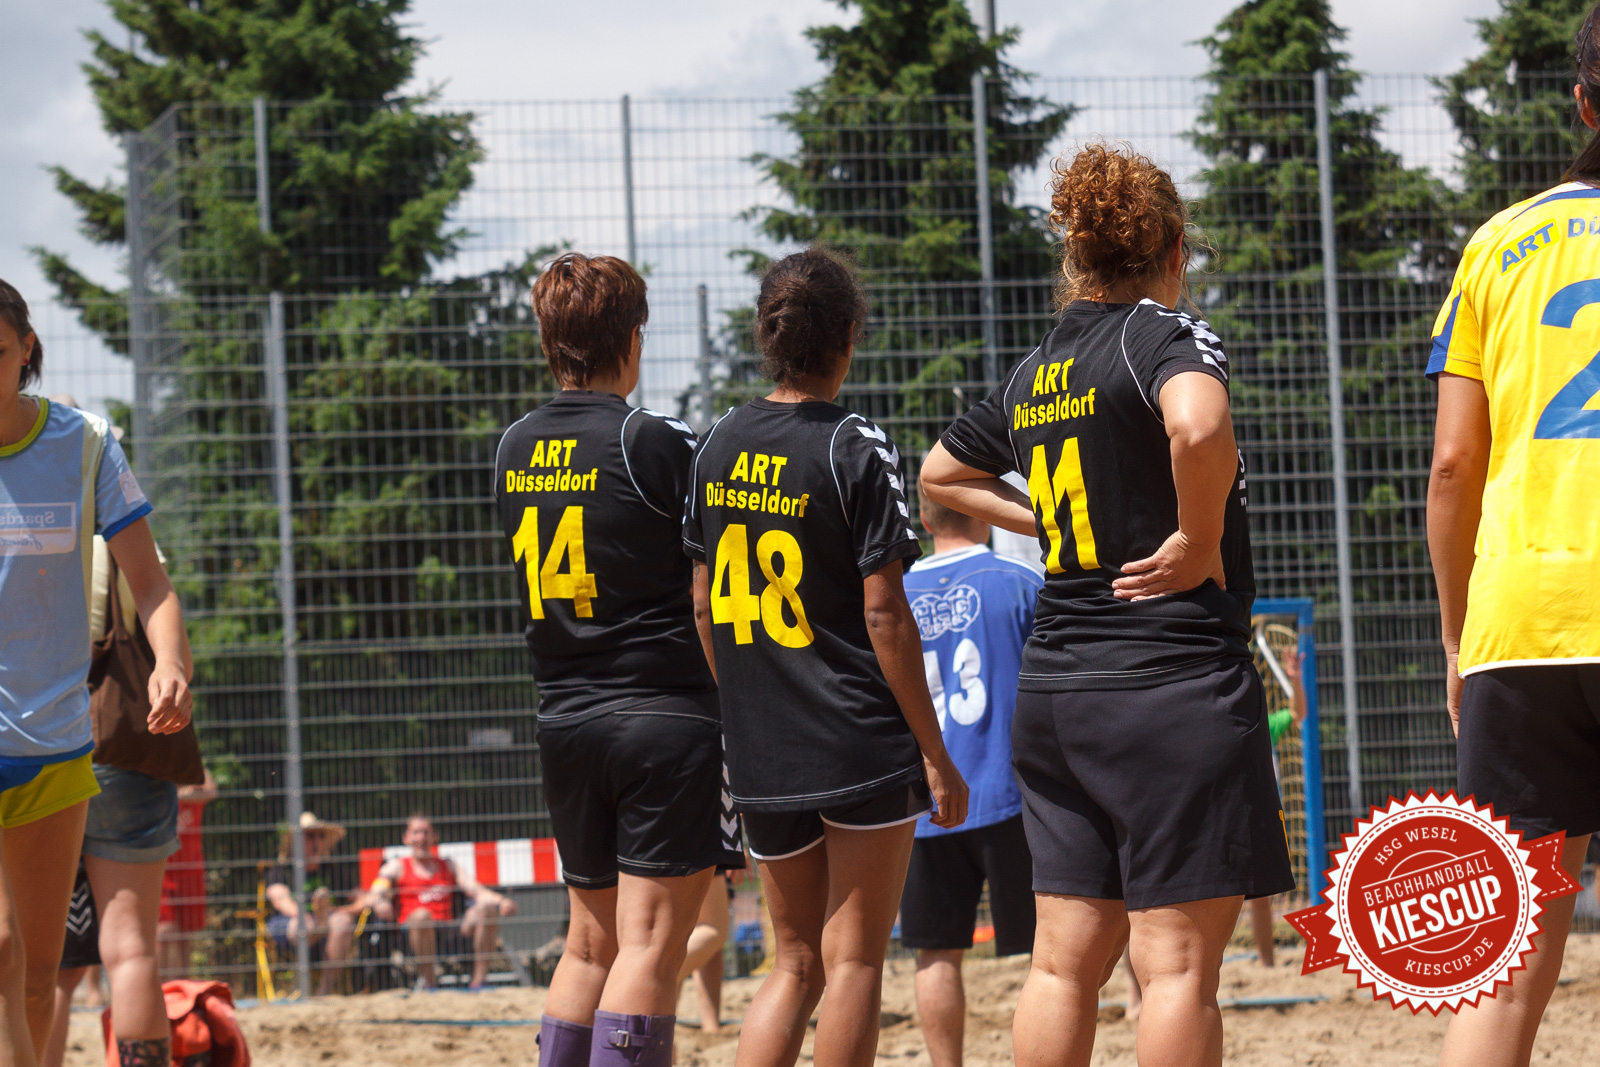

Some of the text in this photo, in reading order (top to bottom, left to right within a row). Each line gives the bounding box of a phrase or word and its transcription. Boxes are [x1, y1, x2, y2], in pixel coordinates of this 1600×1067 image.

[1502, 222, 1554, 274] ART
[1032, 357, 1075, 398] ART
[1014, 387, 1096, 430] Düsseldorf
[530, 439, 577, 468] ART
[730, 451, 787, 486] ART
[506, 468, 598, 493] Düsseldorf
[706, 482, 809, 518] Düsseldorf
[1028, 437, 1101, 574] 11
[512, 505, 598, 619] 14
[710, 523, 814, 648] 48
